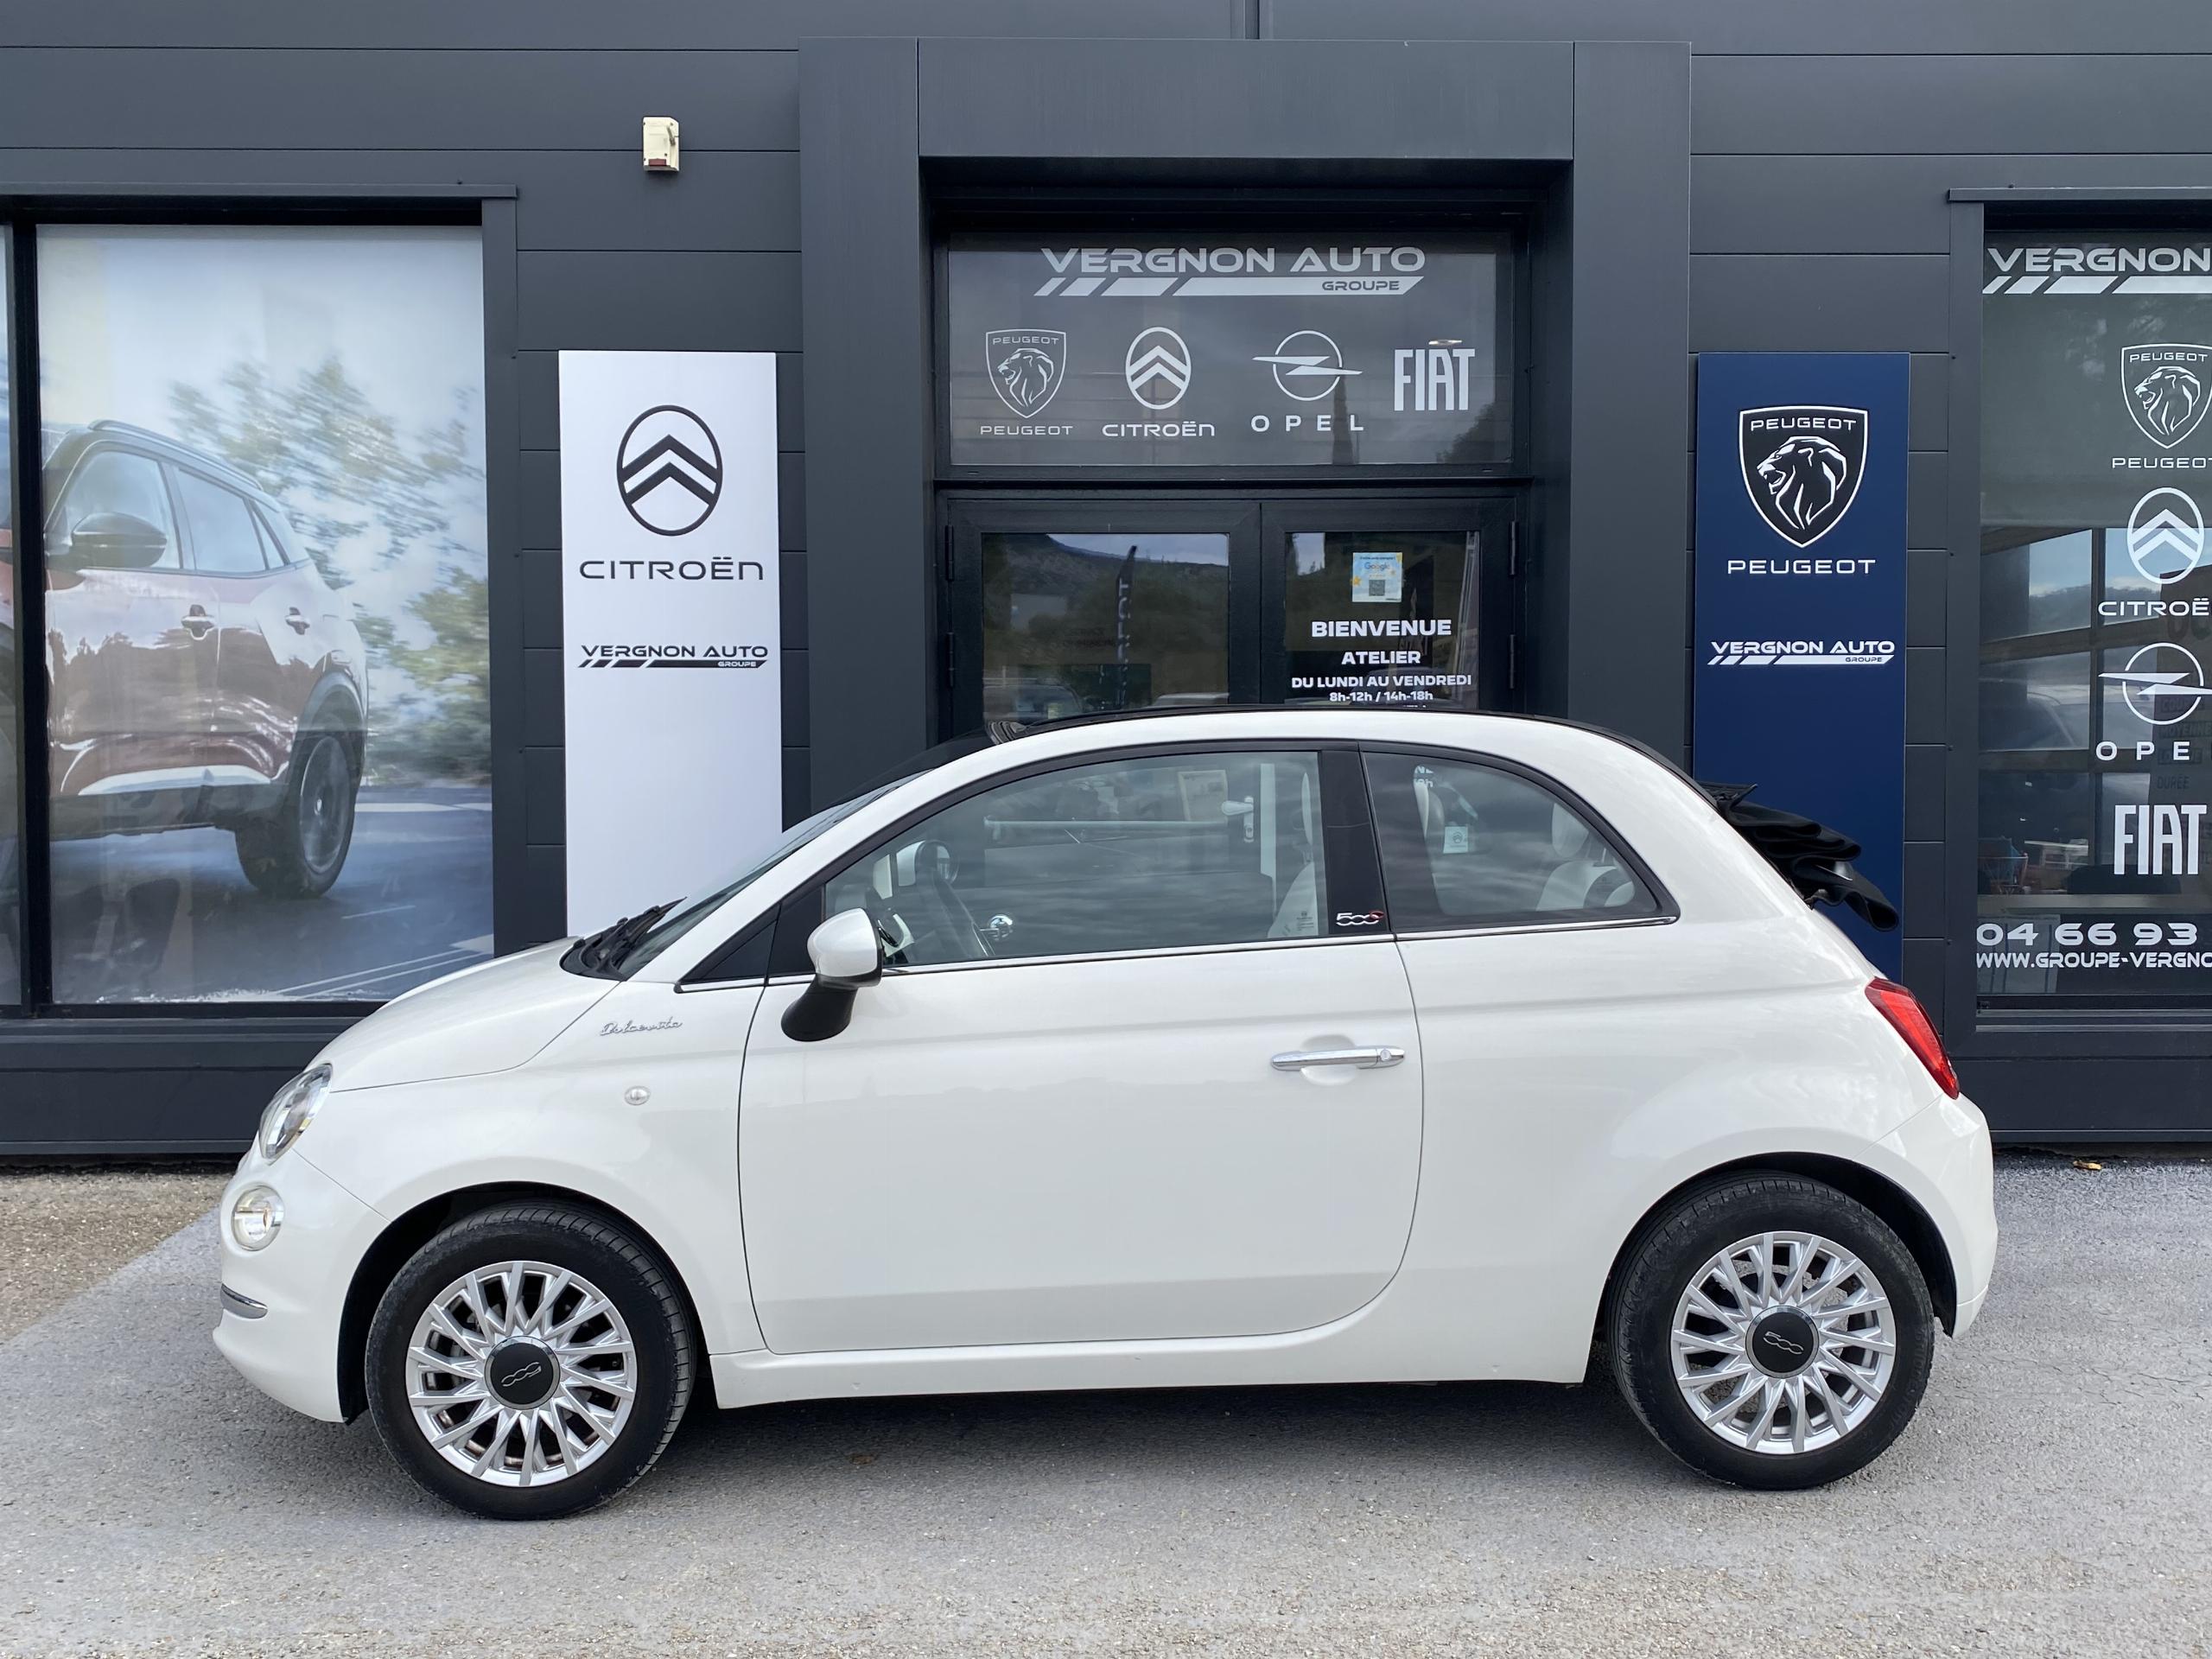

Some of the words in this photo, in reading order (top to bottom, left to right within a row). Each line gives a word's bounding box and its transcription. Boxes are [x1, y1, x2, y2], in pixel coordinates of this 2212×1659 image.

[1041, 248, 1274, 272] VERGNON
[1290, 247, 1426, 271] AUTO
[1987, 247, 2211, 272] VERGNON
[1322, 280, 1401, 291] GROUPE
[993, 336, 1059, 346] PEUGEOT
[2130, 353, 2209, 363] PEUGEOT
[1394, 348, 1475, 411] FIAT
[981, 425, 1073, 435] PEUGEOT
[1751, 417, 1857, 431] PEUGEOT
[1727, 560, 1876, 574] PEUGEOT
[1312, 620, 1452, 637] BIENVENUE
[581, 645, 696, 658] VERGNON
[702, 645, 768, 658] AUTO
[1711, 641, 1823, 654] VERGNON
[1828, 641, 1895, 654] AUTO
[1341, 651, 1421, 665] ATELIER
[1291, 677, 1314, 689] DU
[1317, 676, 1363, 688] LUNDI
[1366, 676, 1389, 687] AU
[1392, 675, 1472, 687] VENDREDI
[1329, 691, 1373, 702] 8h-12h
[1383, 691, 1433, 702] 14h-18h
[2113, 804, 2207, 874] FIAT
[1976, 923, 2039, 946] 04
[2054, 923, 2117, 946] 66
[2133, 923, 2197, 946] 93
